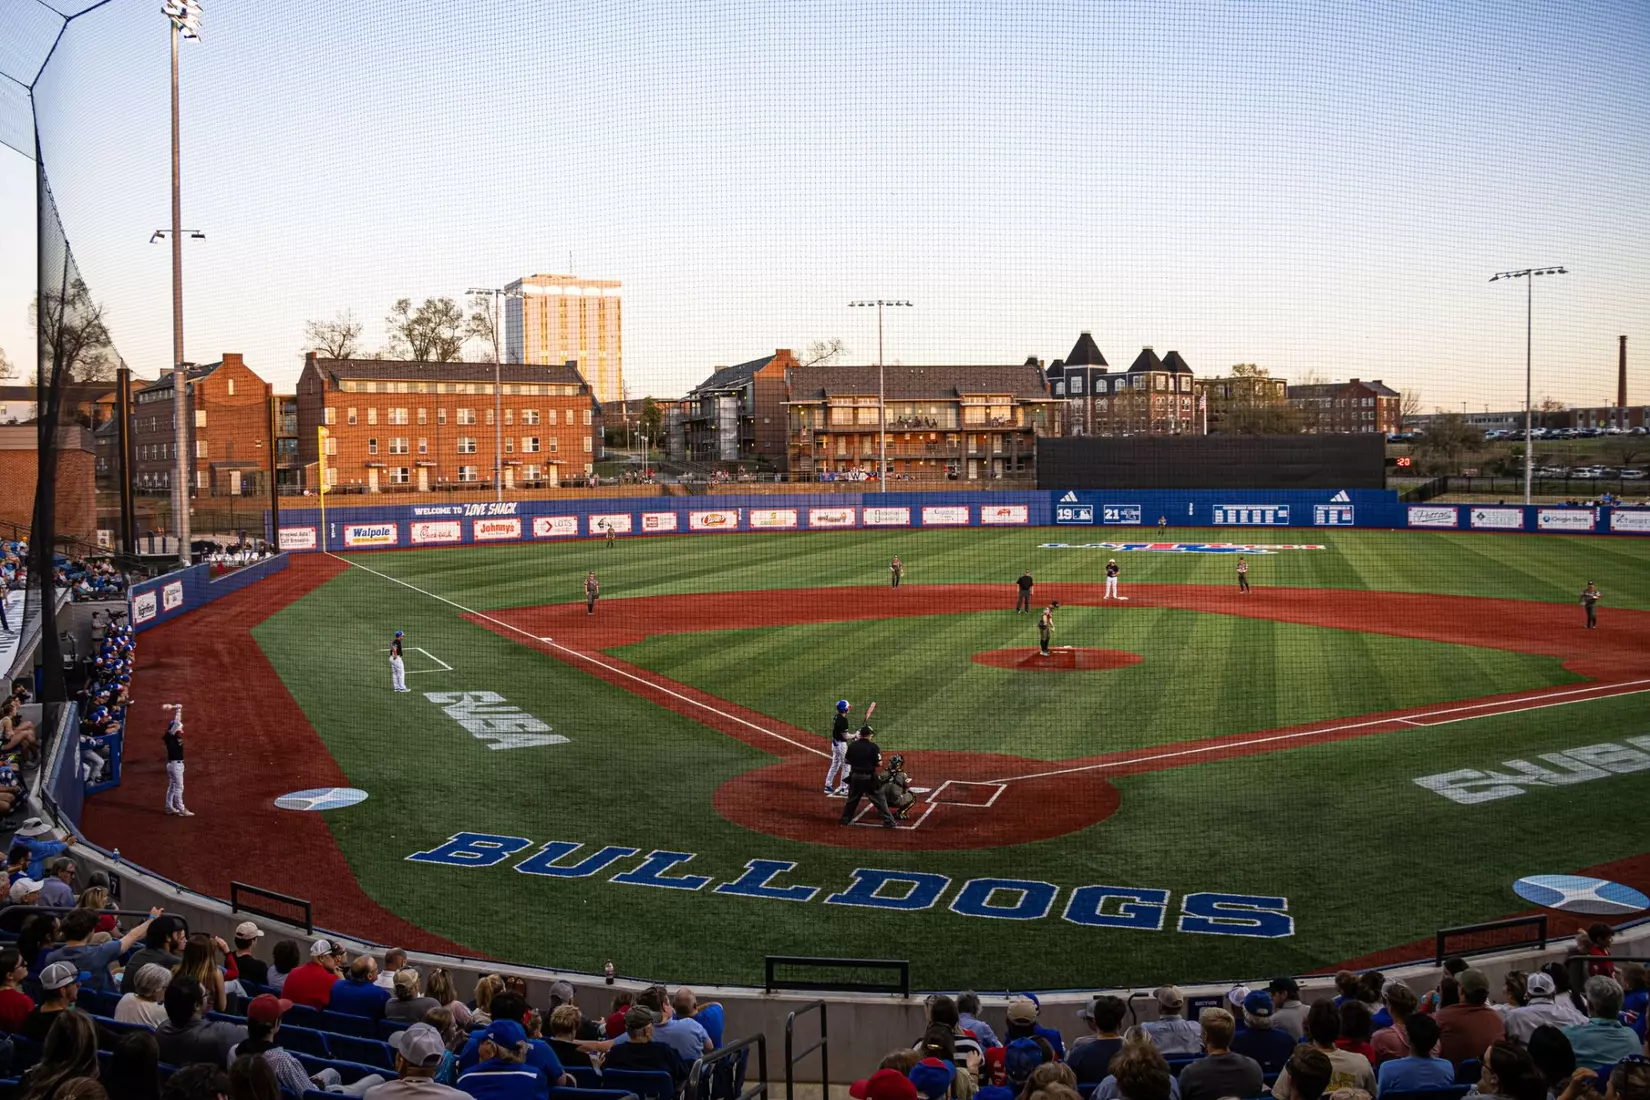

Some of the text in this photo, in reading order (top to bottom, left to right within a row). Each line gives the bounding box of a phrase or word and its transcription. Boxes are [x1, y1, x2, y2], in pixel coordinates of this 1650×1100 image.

[414, 507, 451, 516] WELCOME
[452, 506, 463, 515] TO
[1057, 508, 1073, 520] 19
[1105, 508, 1120, 520] 21
[480, 522, 515, 534] Johnny's
[554, 520, 573, 528] LOTS
[353, 527, 391, 538] Walpole
[1412, 735, 1650, 804] CUS
[404, 831, 1295, 938] BULLDOGS
